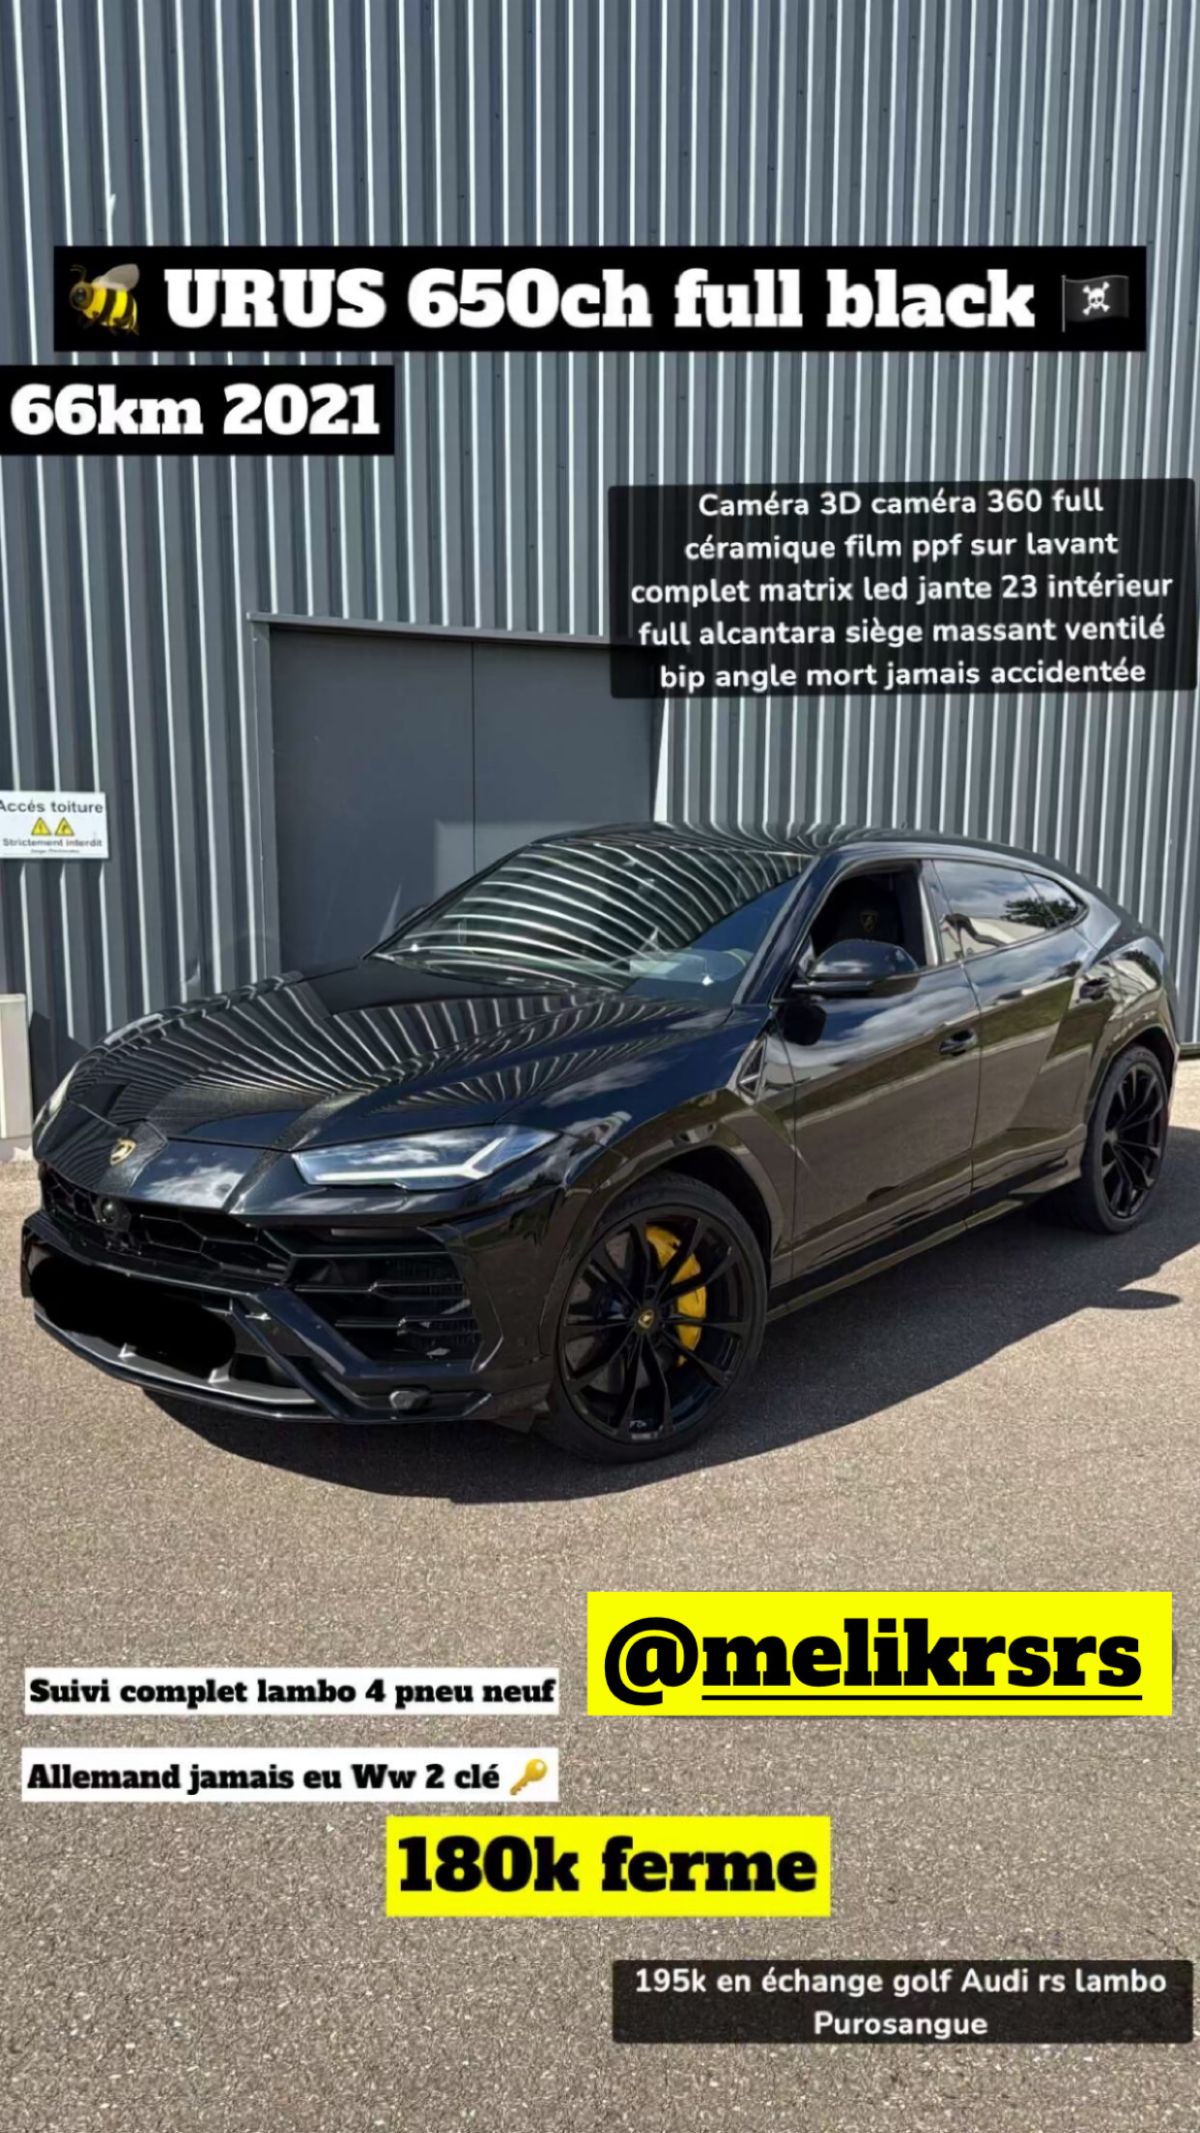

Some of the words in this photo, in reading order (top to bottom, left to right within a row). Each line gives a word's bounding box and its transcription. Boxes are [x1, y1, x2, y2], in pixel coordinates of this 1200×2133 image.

[51, 801, 103, 813] toiture
[3, 838, 63, 847] Strictement
[66, 839, 102, 847] interdit
